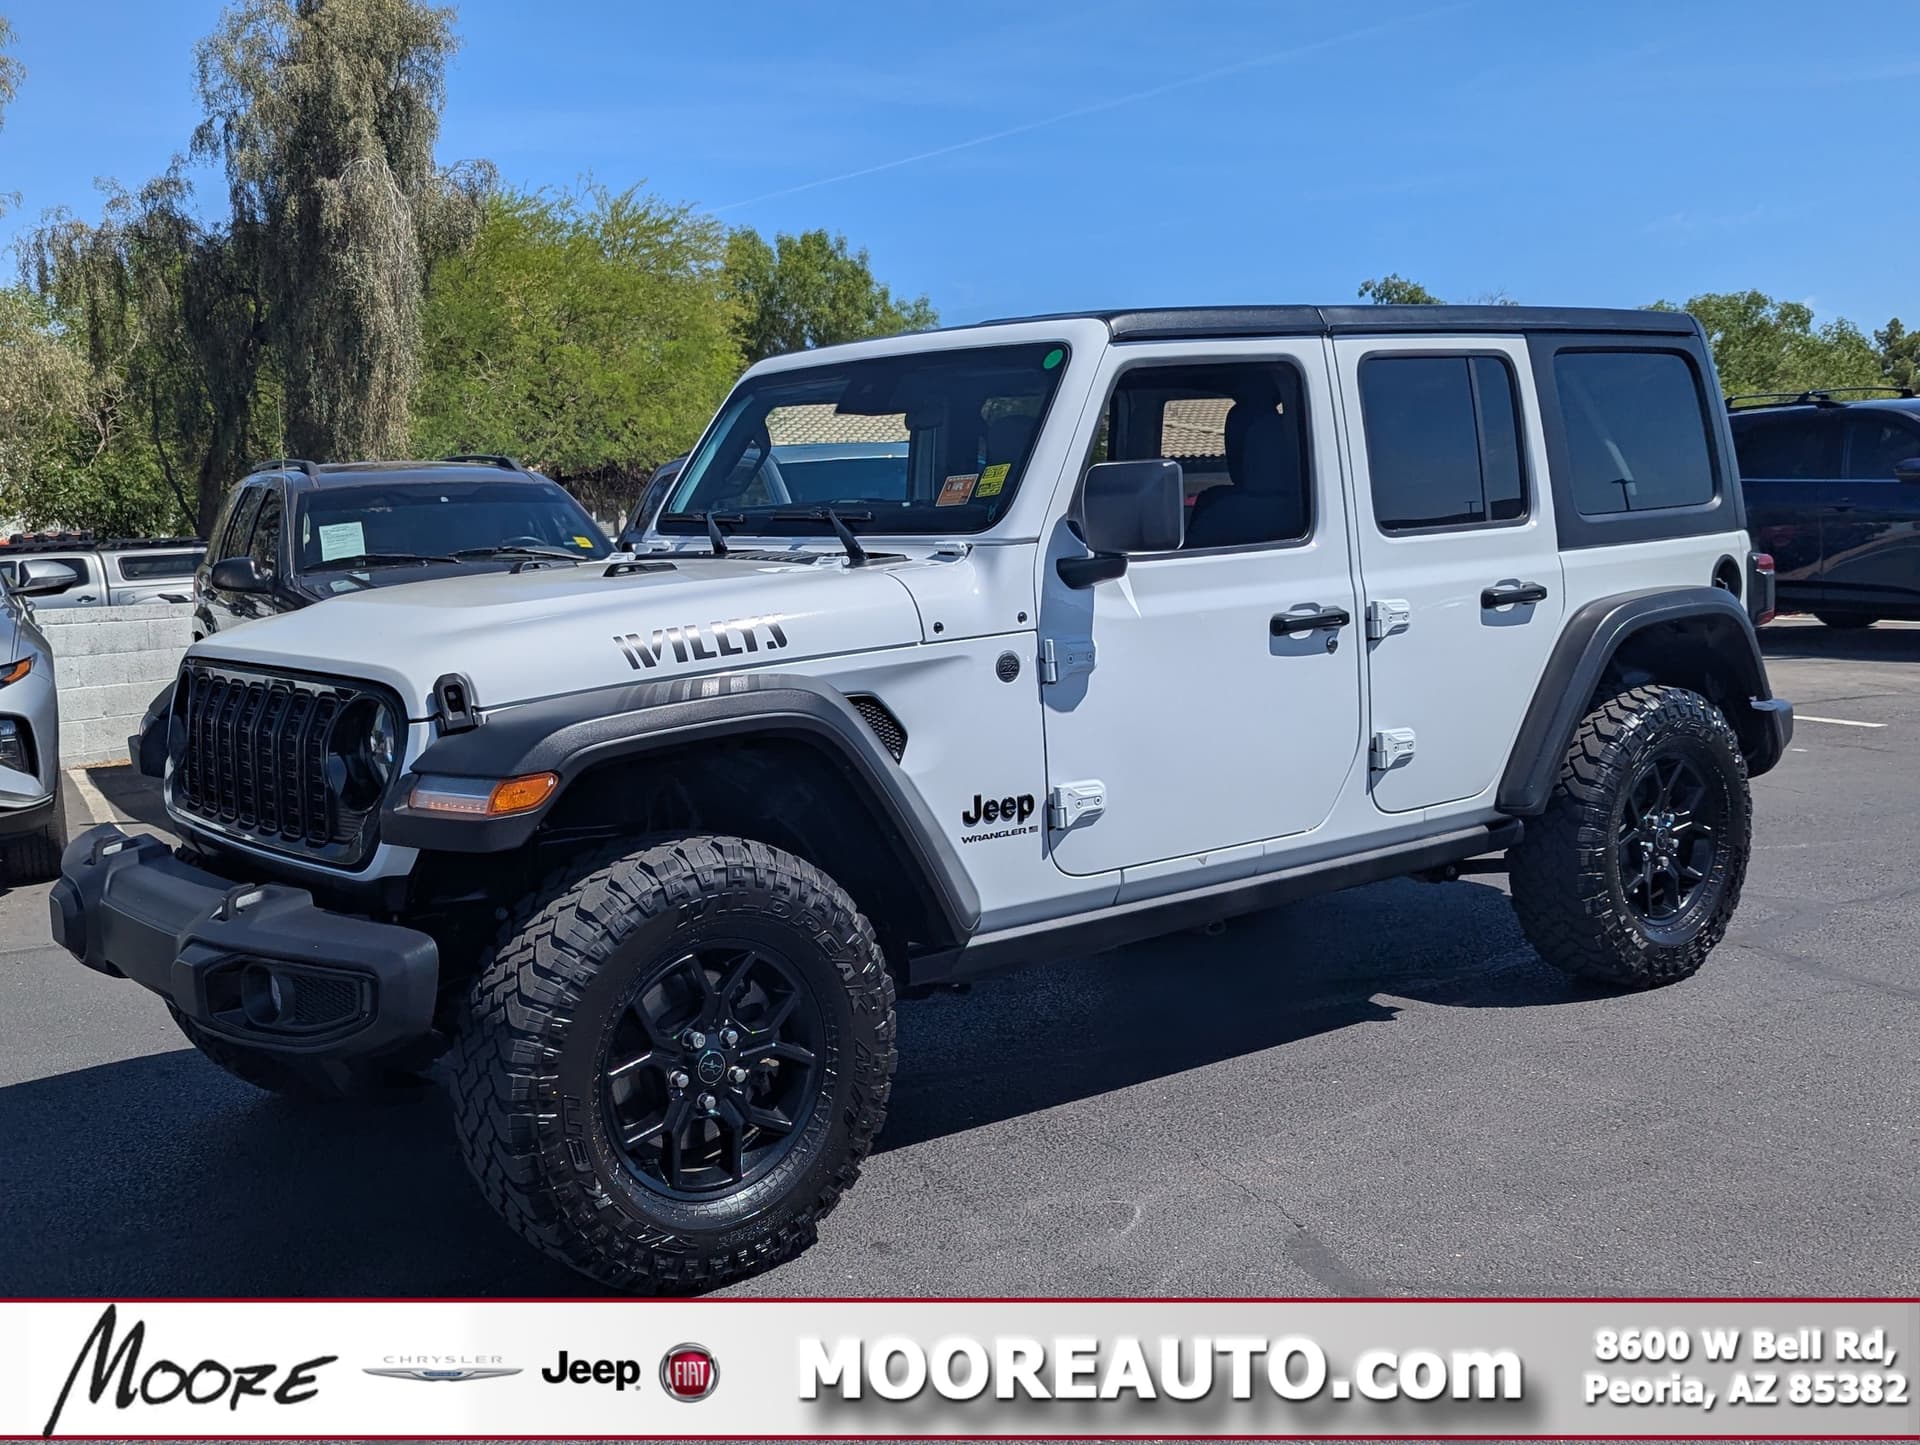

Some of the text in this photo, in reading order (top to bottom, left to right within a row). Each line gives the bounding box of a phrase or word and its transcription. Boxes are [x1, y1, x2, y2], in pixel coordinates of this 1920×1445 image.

[613, 613, 788, 670] WILLYS
[962, 793, 1035, 827] Jeep
[961, 828, 1027, 844] WRANGLER
